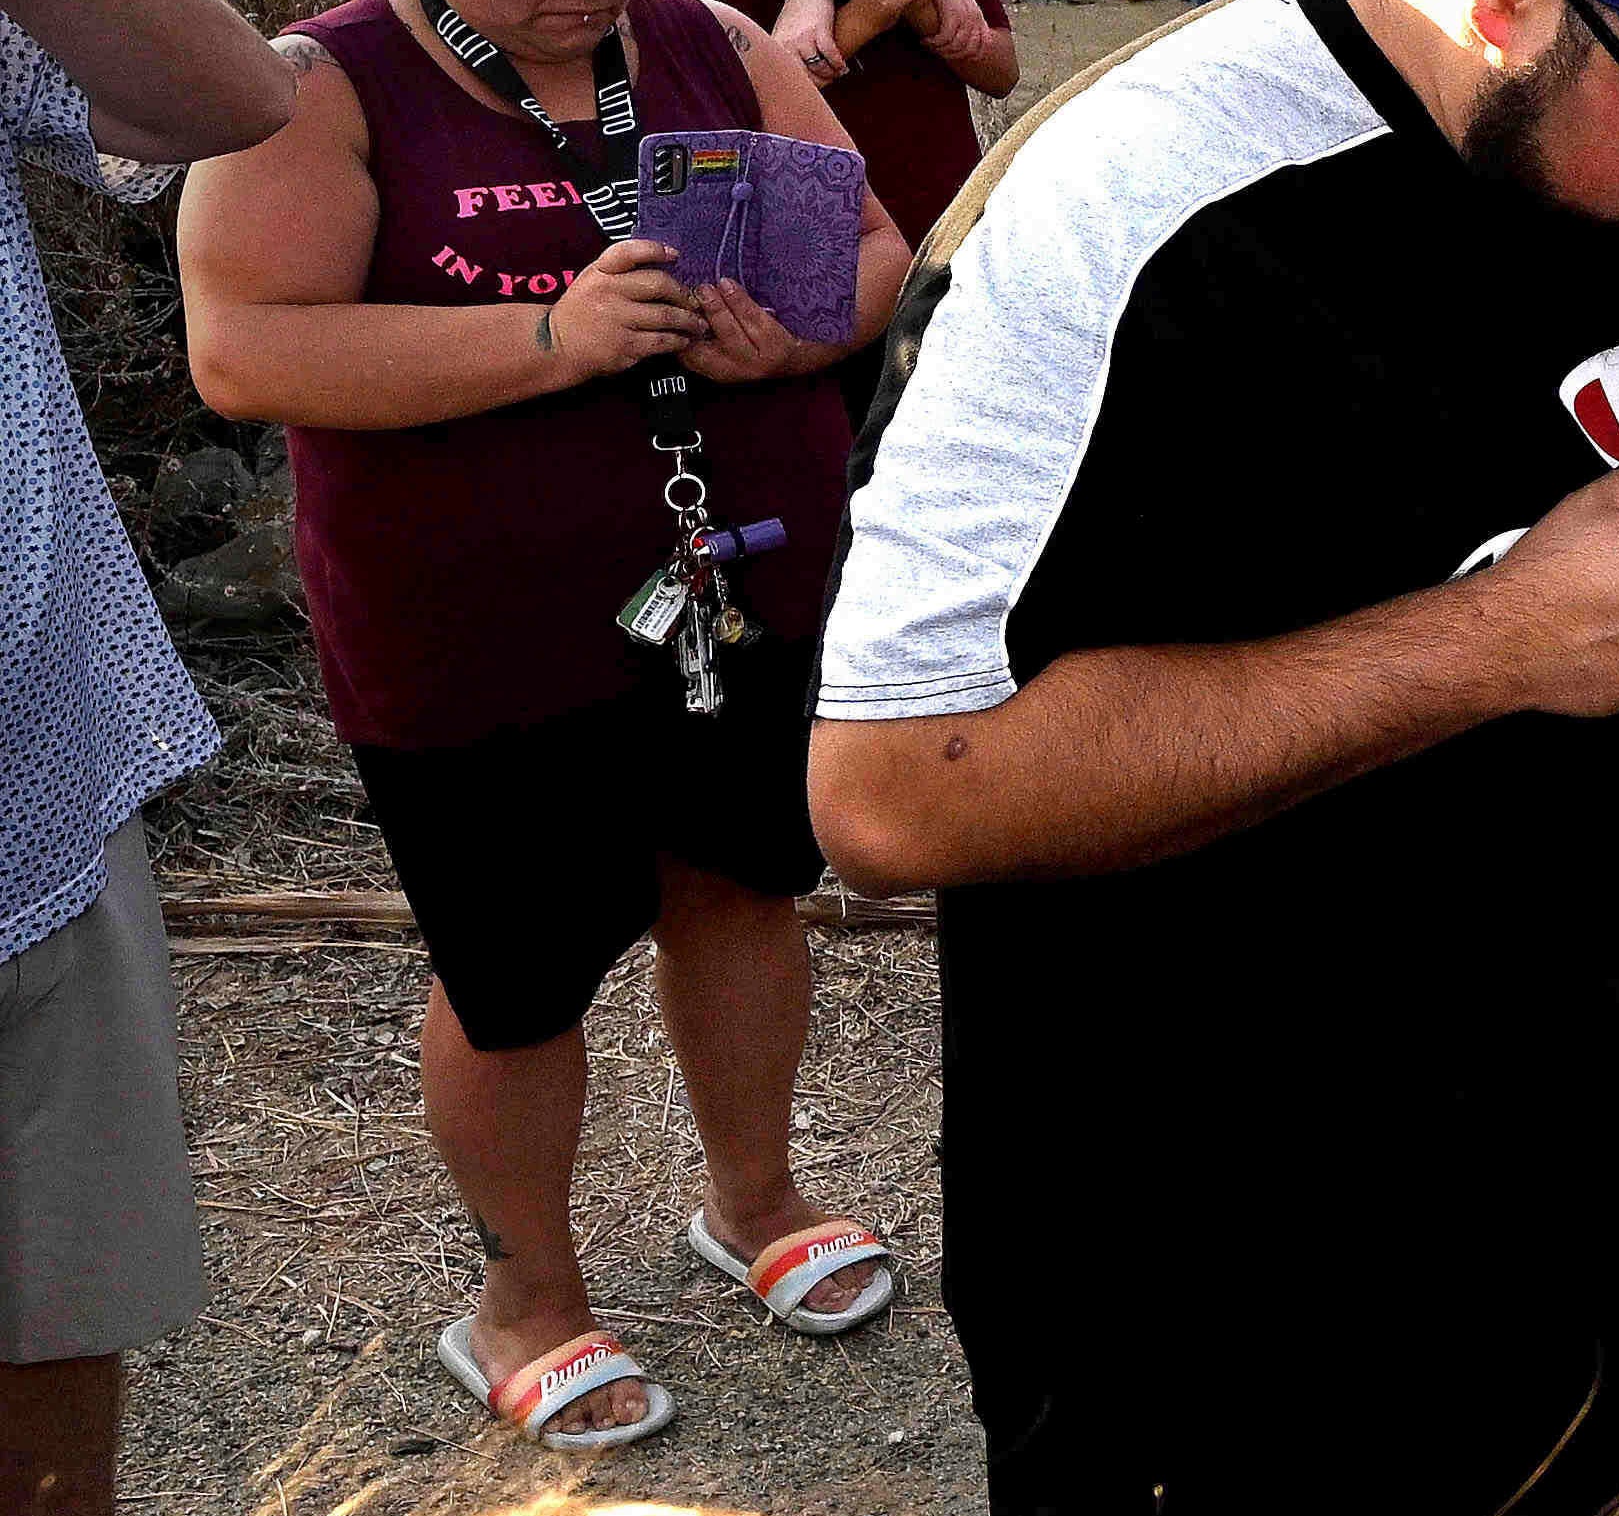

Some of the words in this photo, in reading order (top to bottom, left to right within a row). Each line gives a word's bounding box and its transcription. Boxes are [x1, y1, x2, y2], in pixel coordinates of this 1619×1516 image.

[437, 9, 498, 67] LITTO
[599, 80, 636, 135] LITTO
[431, 245, 484, 284] IN
[650, 376, 686, 397] LITTO
